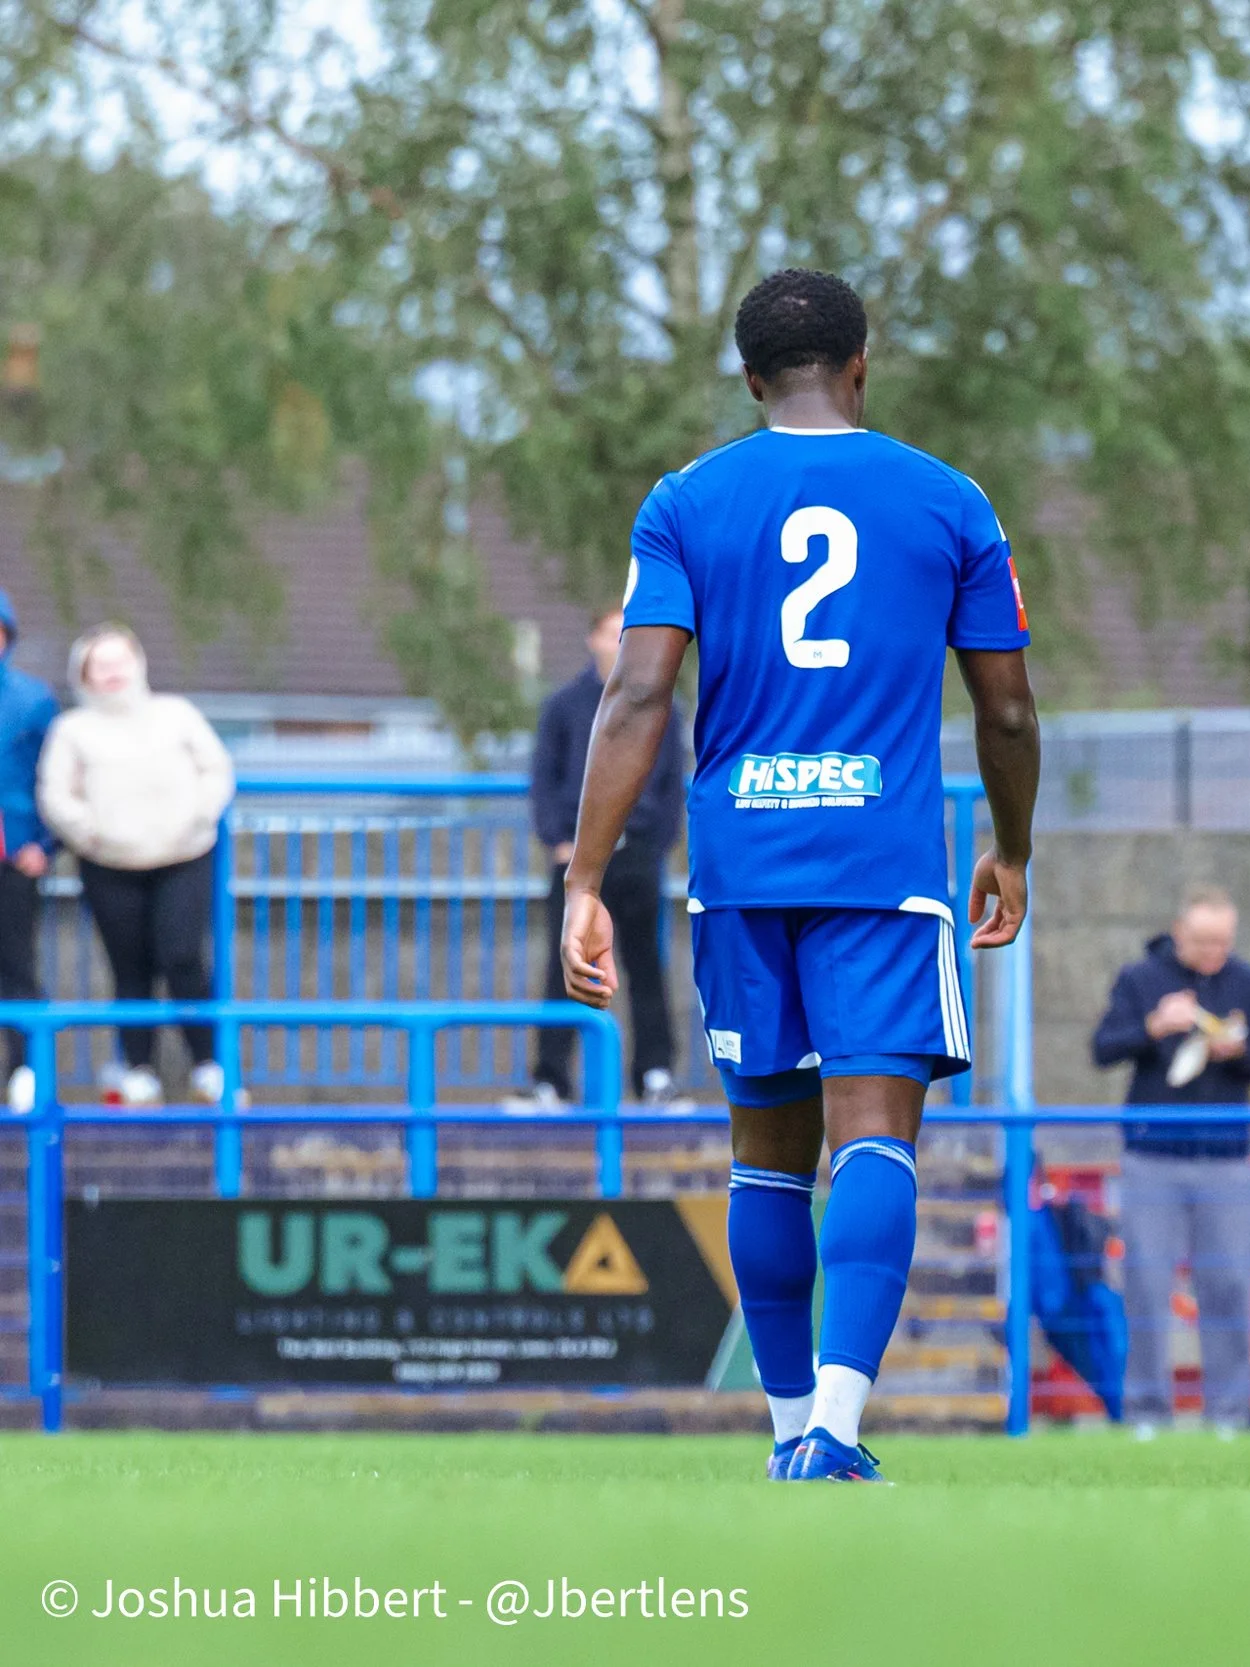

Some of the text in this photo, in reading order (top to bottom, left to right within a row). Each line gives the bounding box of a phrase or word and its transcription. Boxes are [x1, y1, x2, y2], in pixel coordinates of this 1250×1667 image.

[780, 505, 858, 668] 2
[738, 756, 865, 794] HiSPEC
[237, 1210, 650, 1296] UR-EKA
